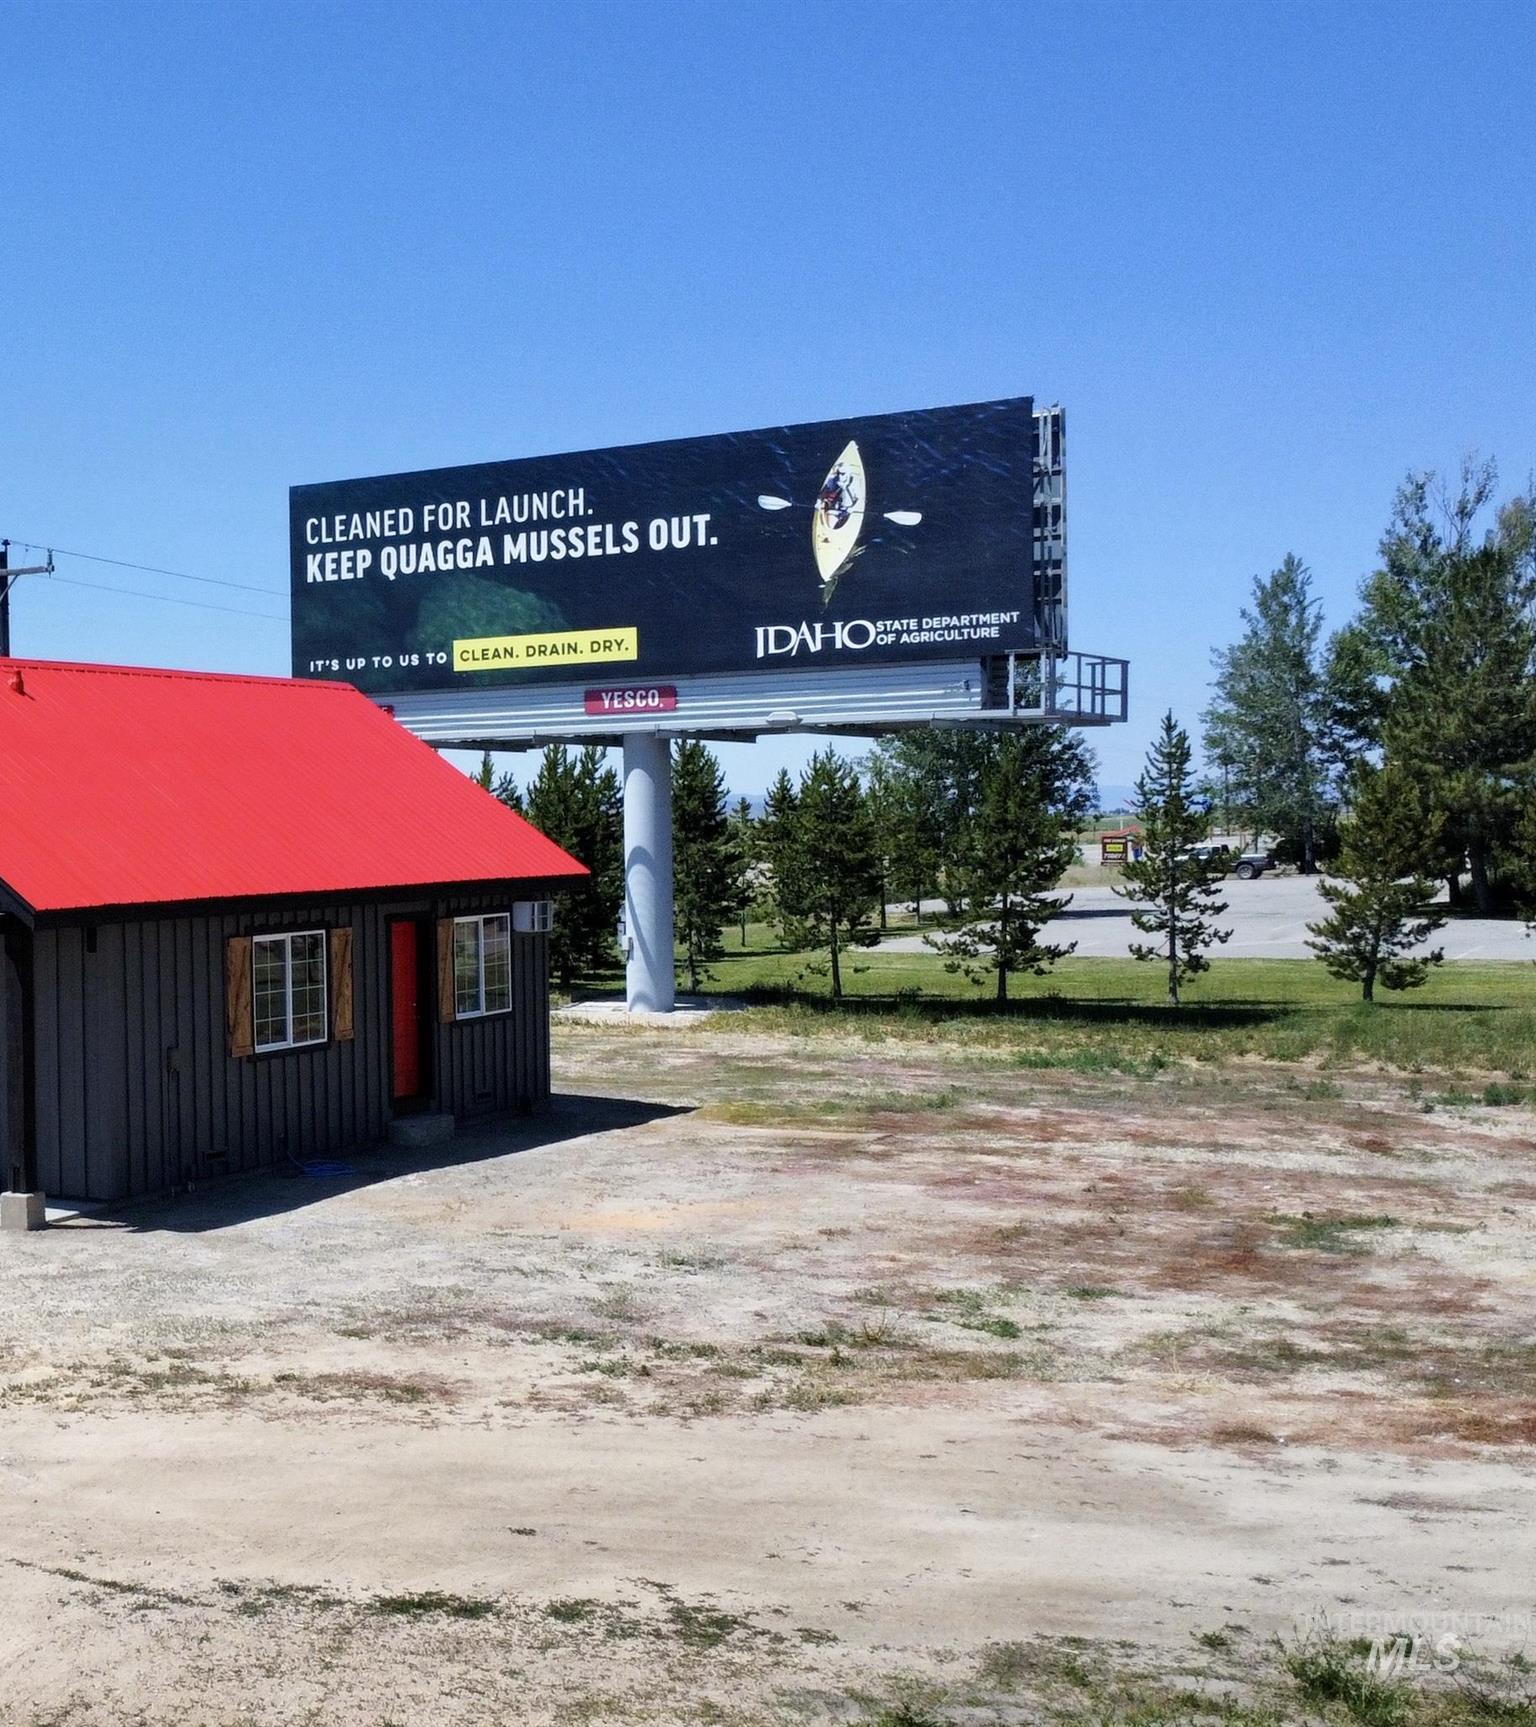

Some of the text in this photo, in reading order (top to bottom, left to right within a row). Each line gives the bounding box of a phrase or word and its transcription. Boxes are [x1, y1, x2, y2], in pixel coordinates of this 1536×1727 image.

[306, 487, 593, 544] CLEANED FOR LAUNCH.
[307, 514, 717, 583] KEEP QUAGGA MUSSELS OUT.
[755, 620, 877, 658] IDAHO
[876, 612, 1020, 632] STATE DEPARTMENT
[876, 626, 1000, 646] OF AGRICULTURE
[346, 657, 366, 670] UP
[372, 655, 393, 668] TO
[399, 653, 419, 666] US
[426, 652, 447, 664] TO
[460, 646, 519, 661] CLEAN.
[526, 641, 583, 657] DRAIN.
[590, 638, 629, 653] DRY.
